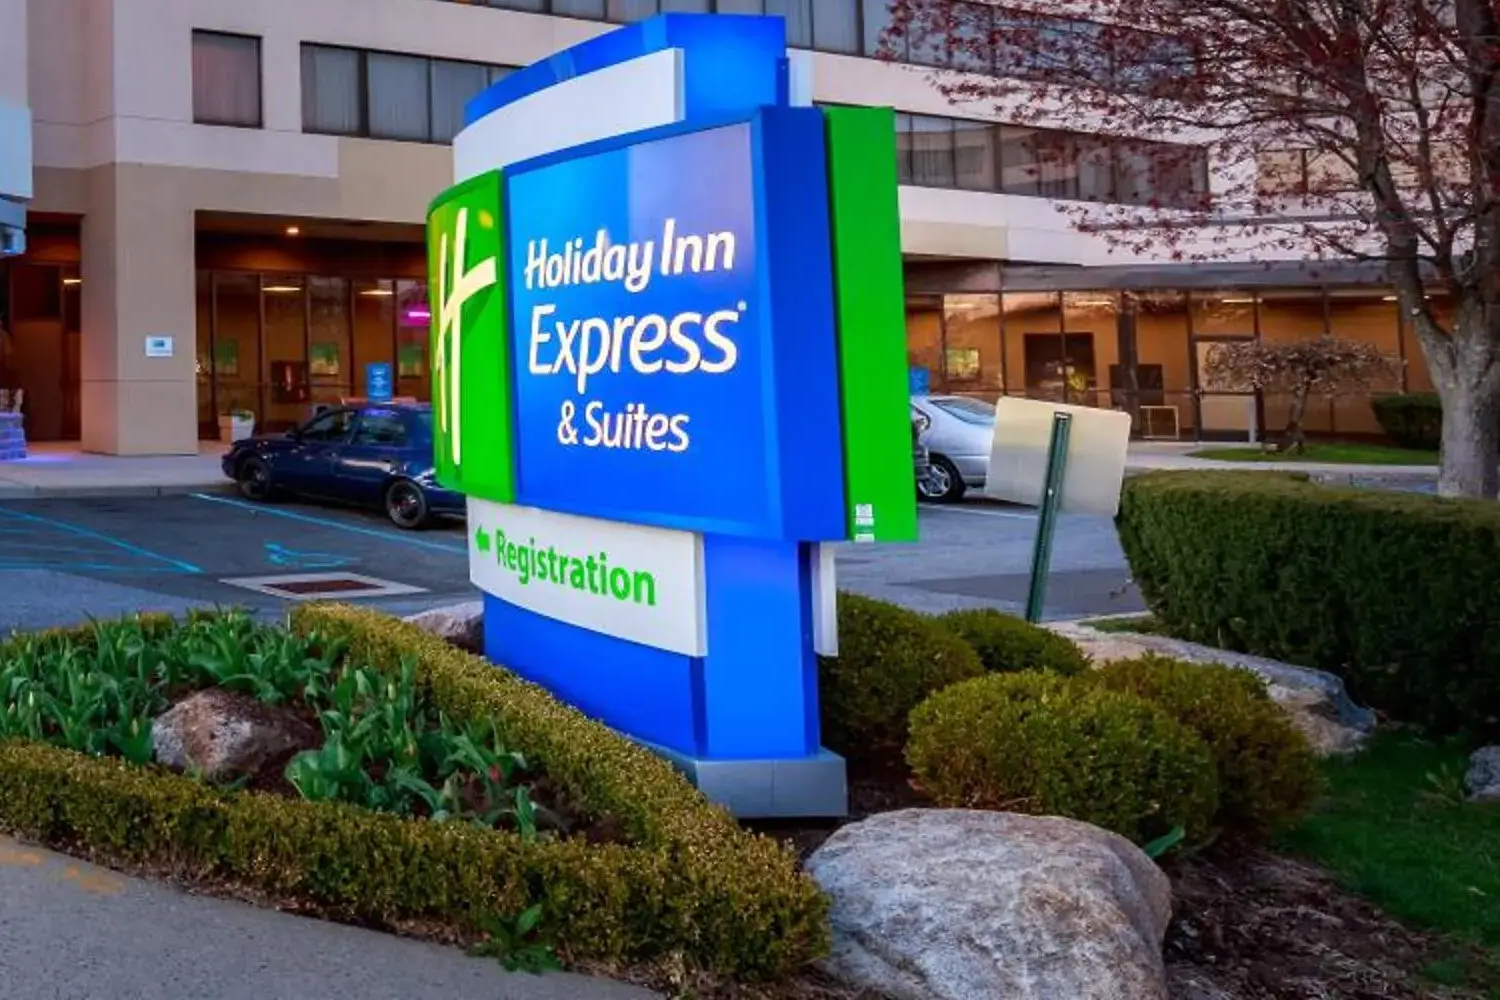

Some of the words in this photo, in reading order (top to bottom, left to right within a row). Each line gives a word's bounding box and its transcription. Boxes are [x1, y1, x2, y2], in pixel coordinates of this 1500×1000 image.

[524, 228, 655, 293] Holiday
[660, 217, 736, 276] Inn
[528, 303, 740, 394] Express
[557, 400, 579, 446] &
[583, 400, 691, 453] Suites
[495, 528, 656, 606] Registration
